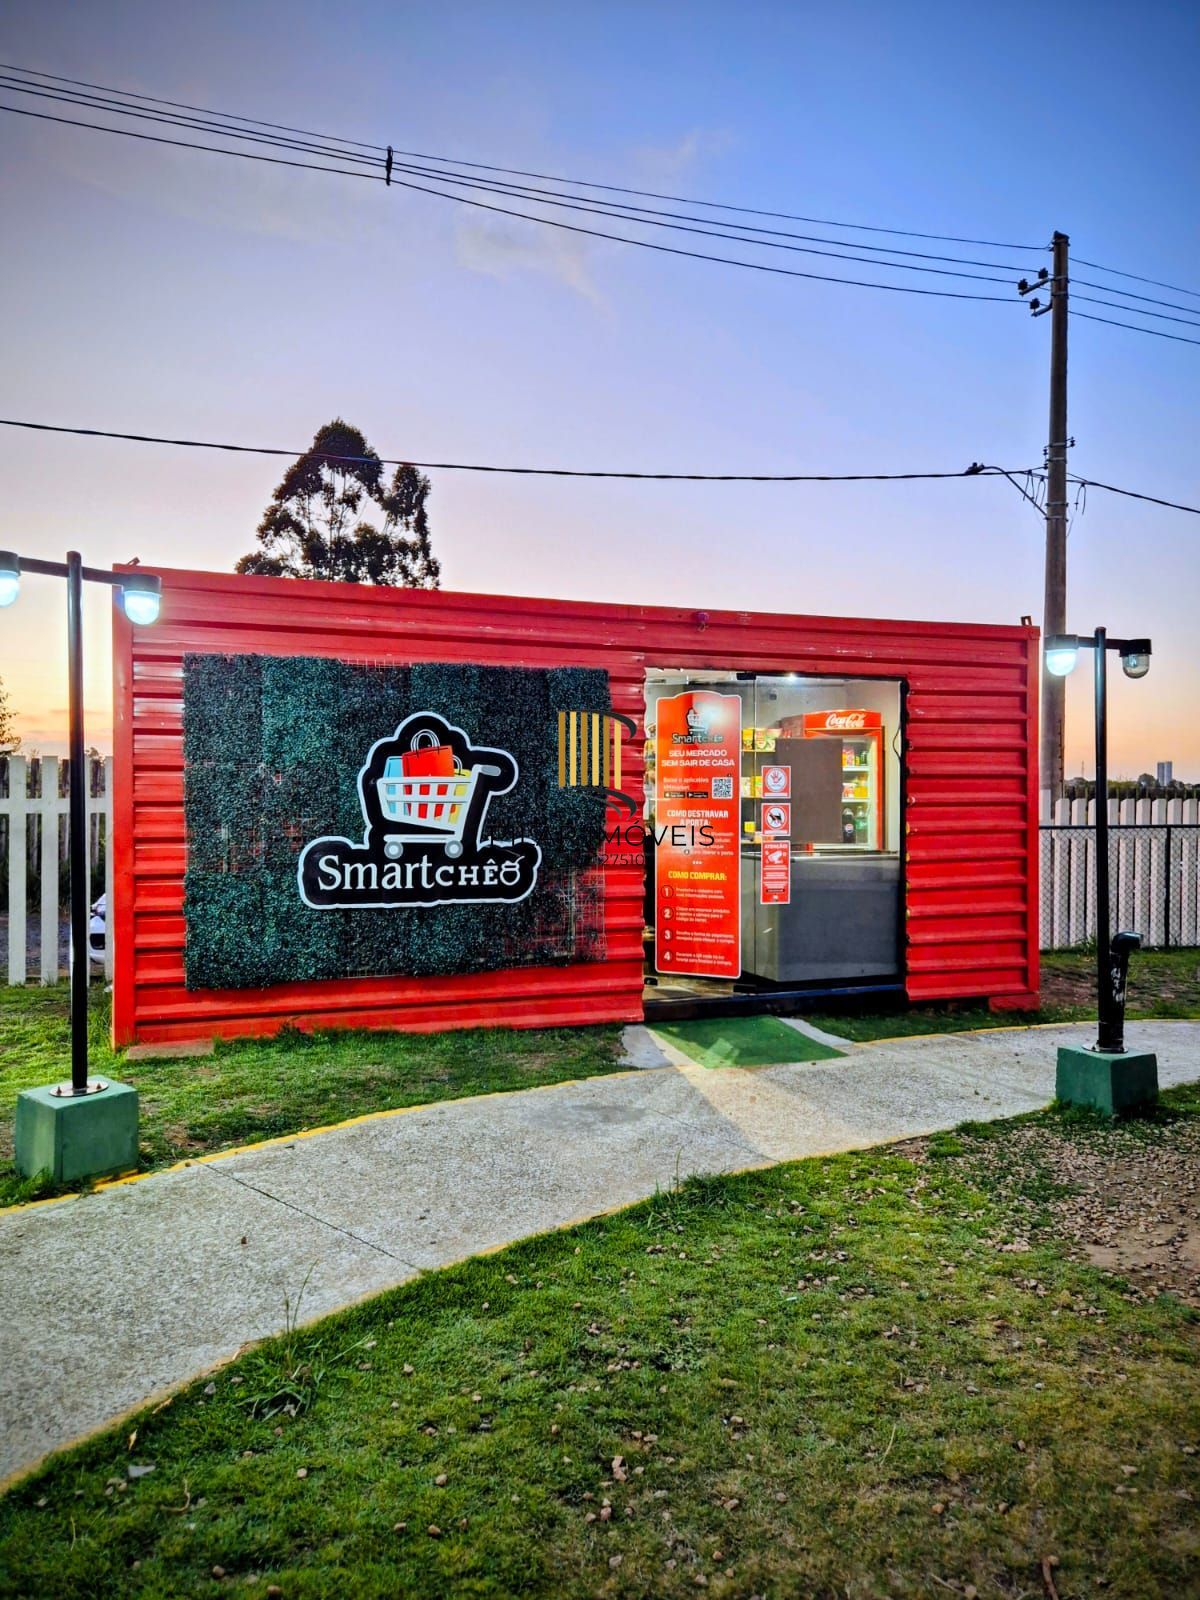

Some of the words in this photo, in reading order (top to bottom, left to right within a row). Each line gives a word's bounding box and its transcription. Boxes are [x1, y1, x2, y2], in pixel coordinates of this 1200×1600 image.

[688, 810, 728, 818] DESTRAVAR
[668, 871, 688, 879] COMO
[689, 872, 727, 880] COMPRAR:
[663, 908, 671, 919] 2
[664, 930, 671, 940] 3
[663, 951, 671, 961] 4
